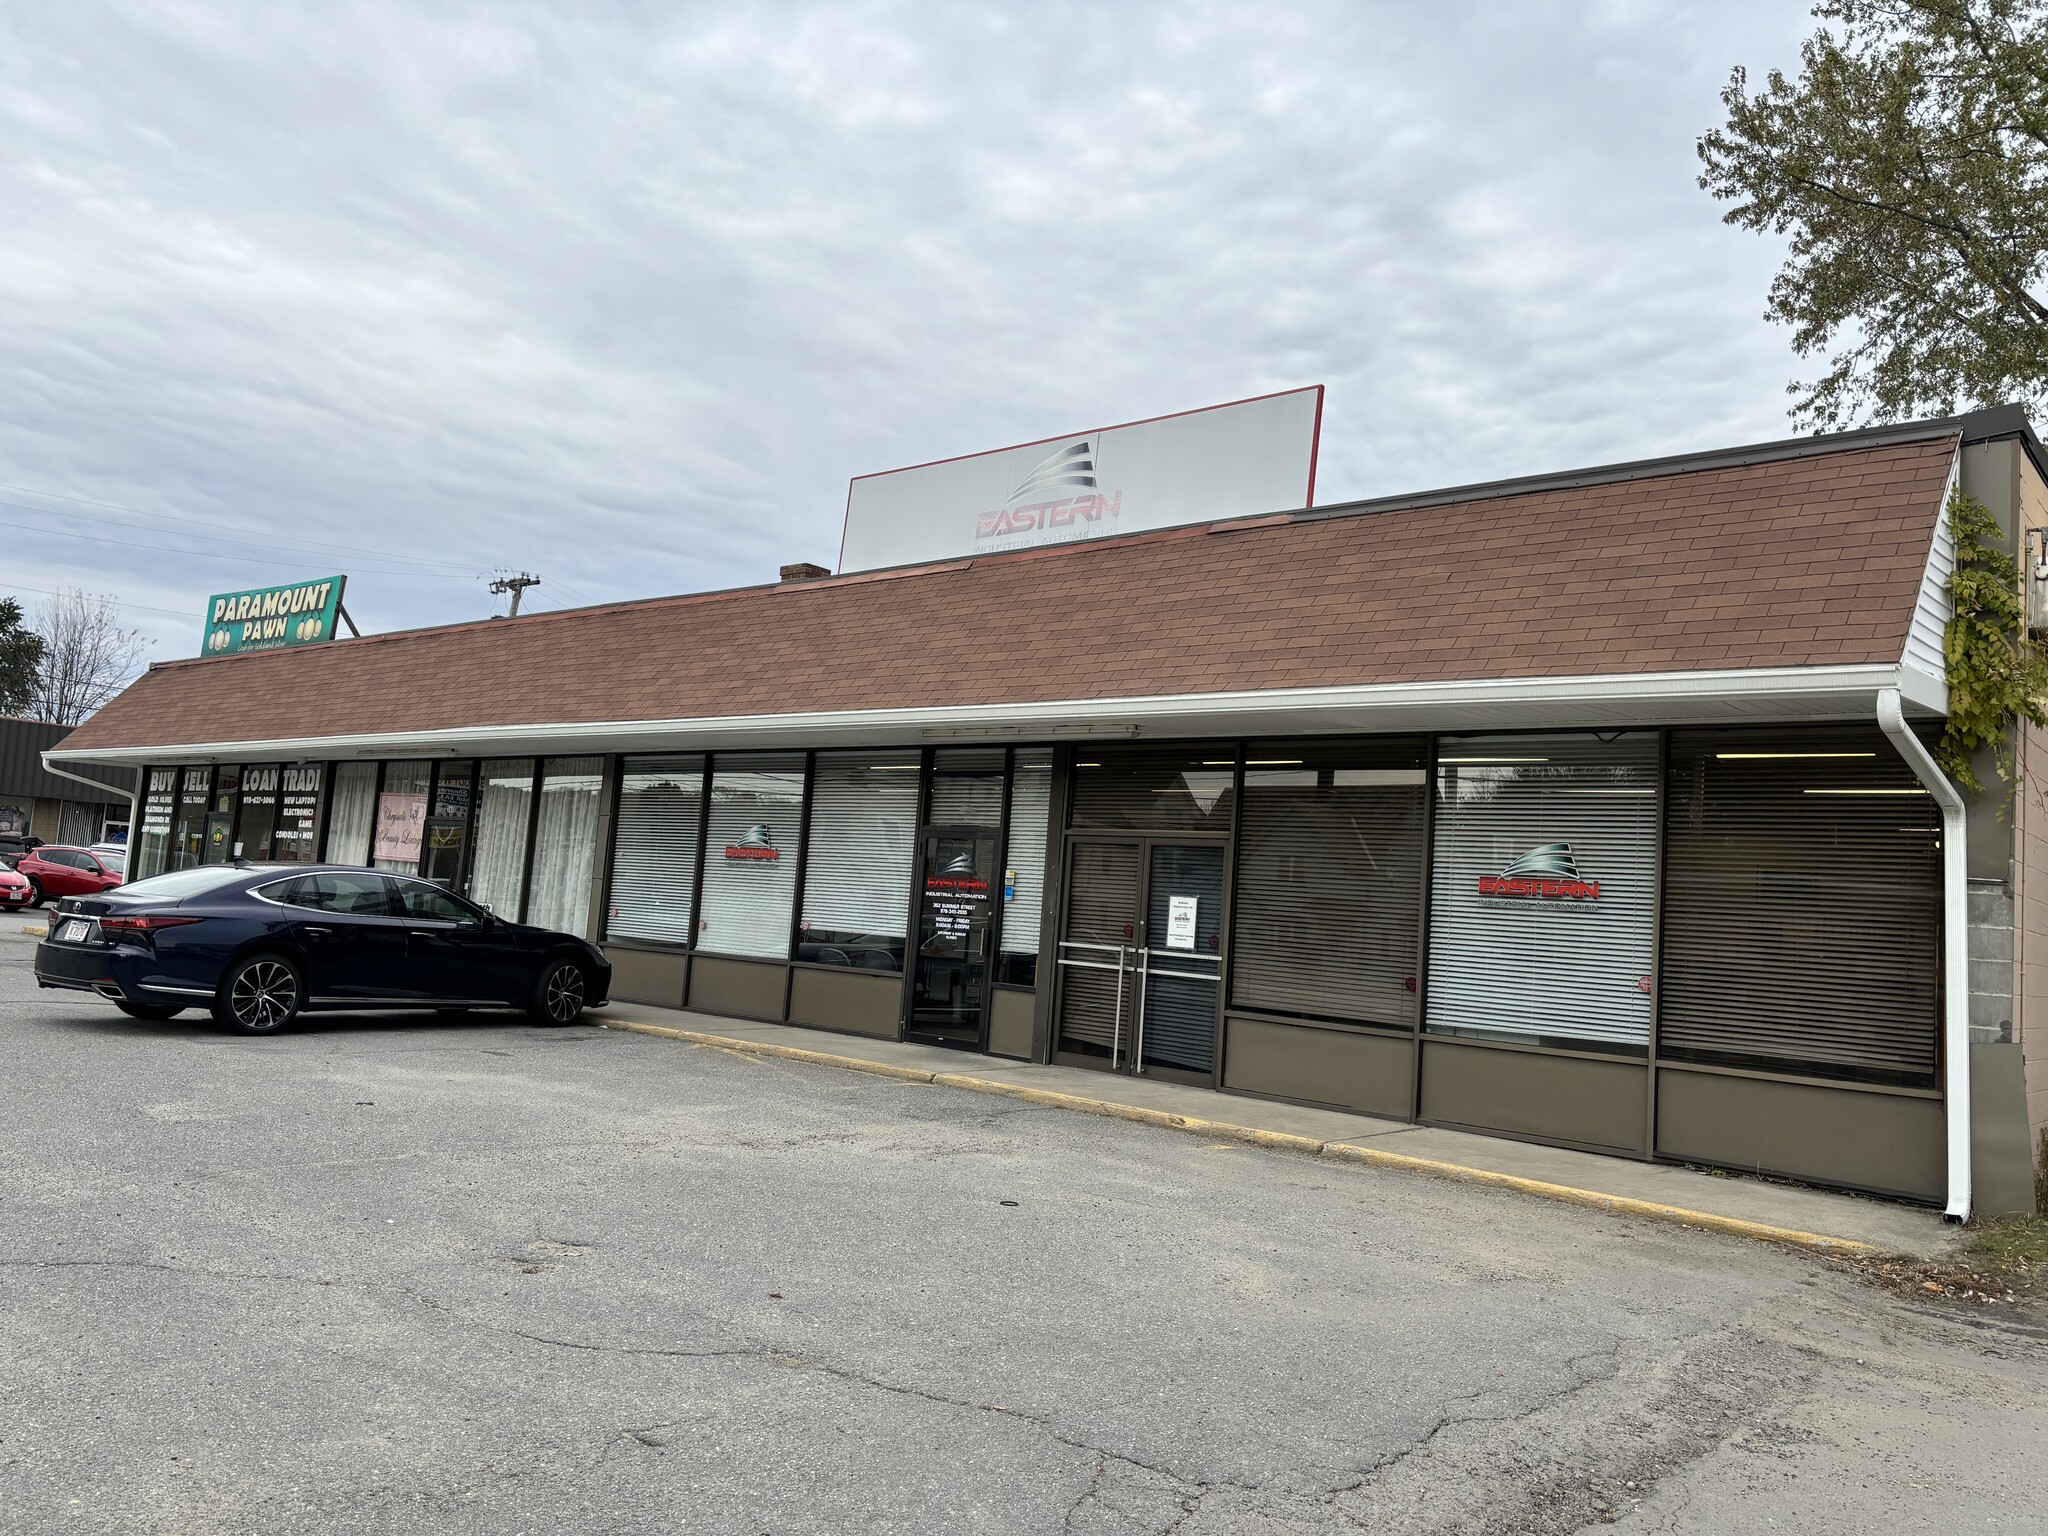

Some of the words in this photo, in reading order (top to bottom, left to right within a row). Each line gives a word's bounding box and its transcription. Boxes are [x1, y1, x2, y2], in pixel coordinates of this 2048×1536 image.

[975, 490, 1123, 539] EASTERN
[212, 582, 332, 623] PARAMOUNT
[242, 616, 288, 641] PAWN
[150, 771, 175, 791] BUY
[183, 771, 209, 791] SELL
[242, 769, 280, 792] LOAN
[183, 796, 193, 804] CALL
[192, 796, 207, 804] TODAY
[284, 796, 296, 804] NEW
[164, 806, 173, 814] AND
[283, 808, 314, 816] ELECTRONICS
[298, 820, 313, 828] GAME
[275, 830, 298, 839] CONSOLES
[725, 846, 779, 860] EASTERN
[927, 877, 988, 890] EASTERN
[1478, 876, 1599, 900] EASTERN
